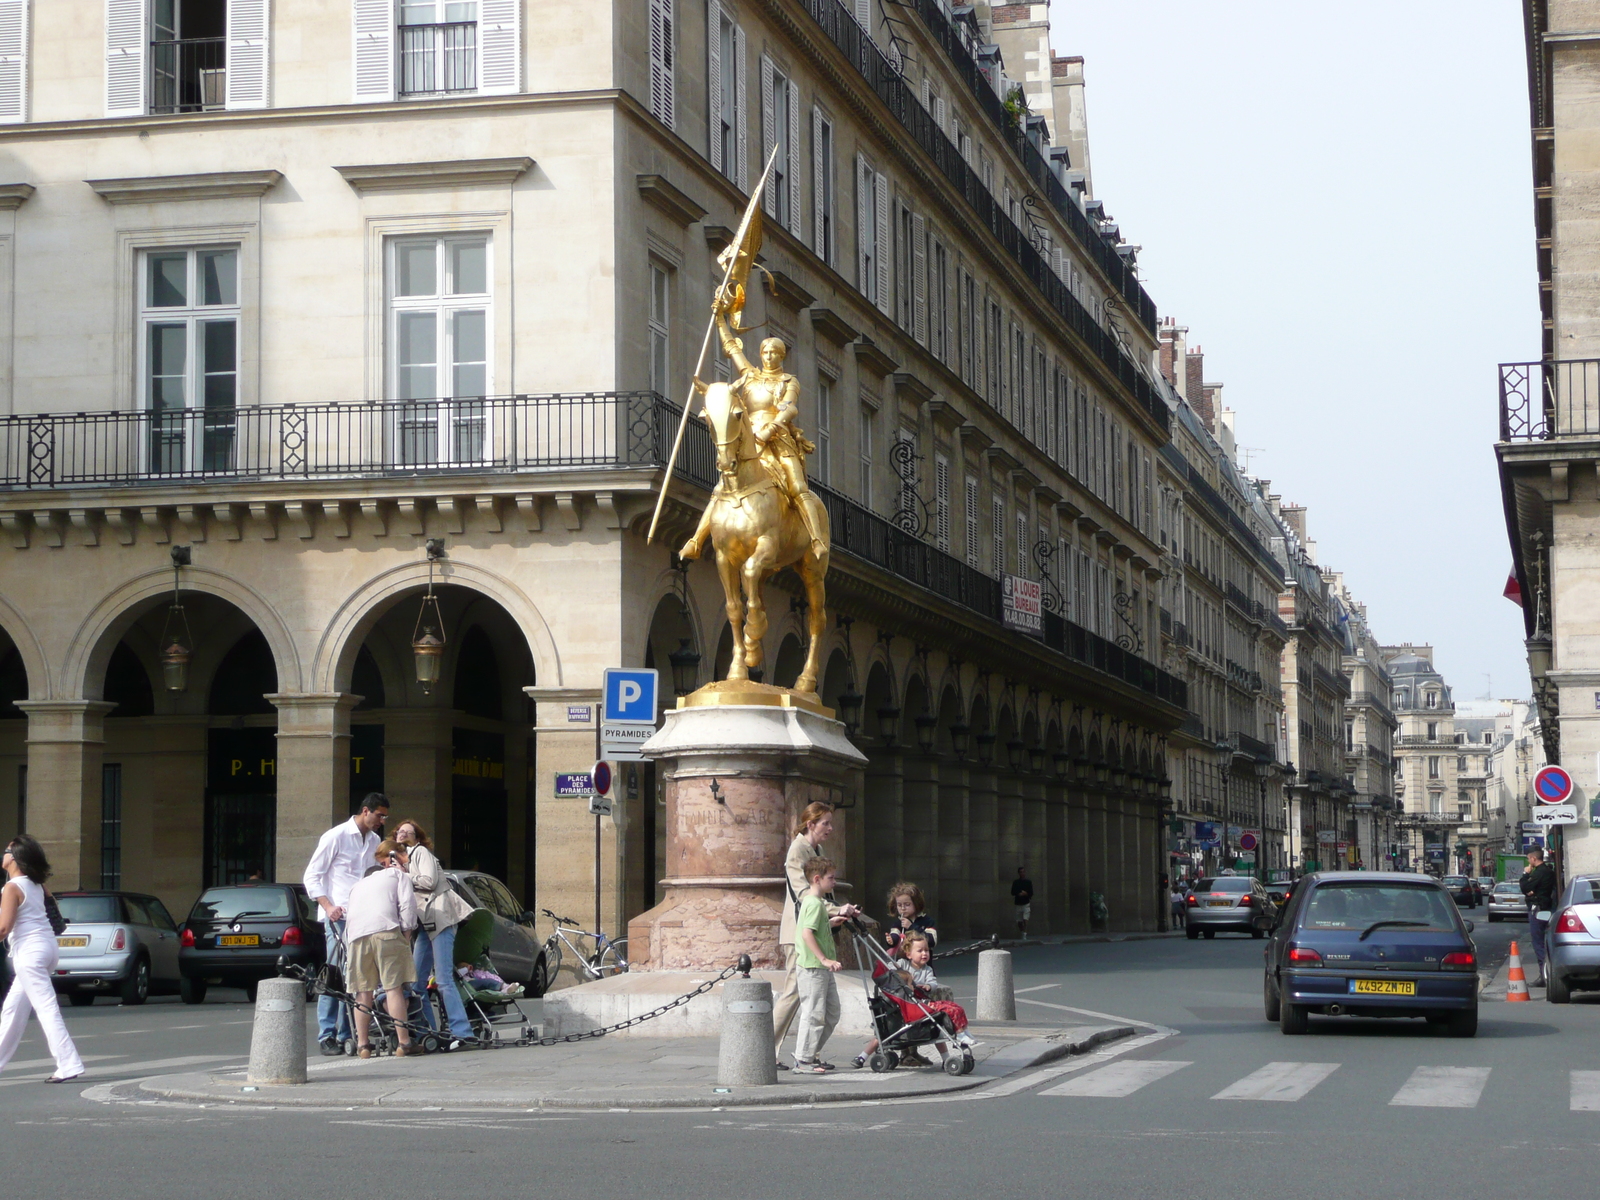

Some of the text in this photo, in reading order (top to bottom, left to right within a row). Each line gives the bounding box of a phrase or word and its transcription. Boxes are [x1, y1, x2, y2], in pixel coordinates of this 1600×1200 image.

[1014, 579, 1040, 600] A LOUER
[1015, 596, 1040, 614] BUREAUX
[618, 680, 642, 712] P
[606, 730, 652, 738] PYRAMIDES
[1358, 980, 1383, 992] 4492
[1399, 982, 1412, 993] 78
